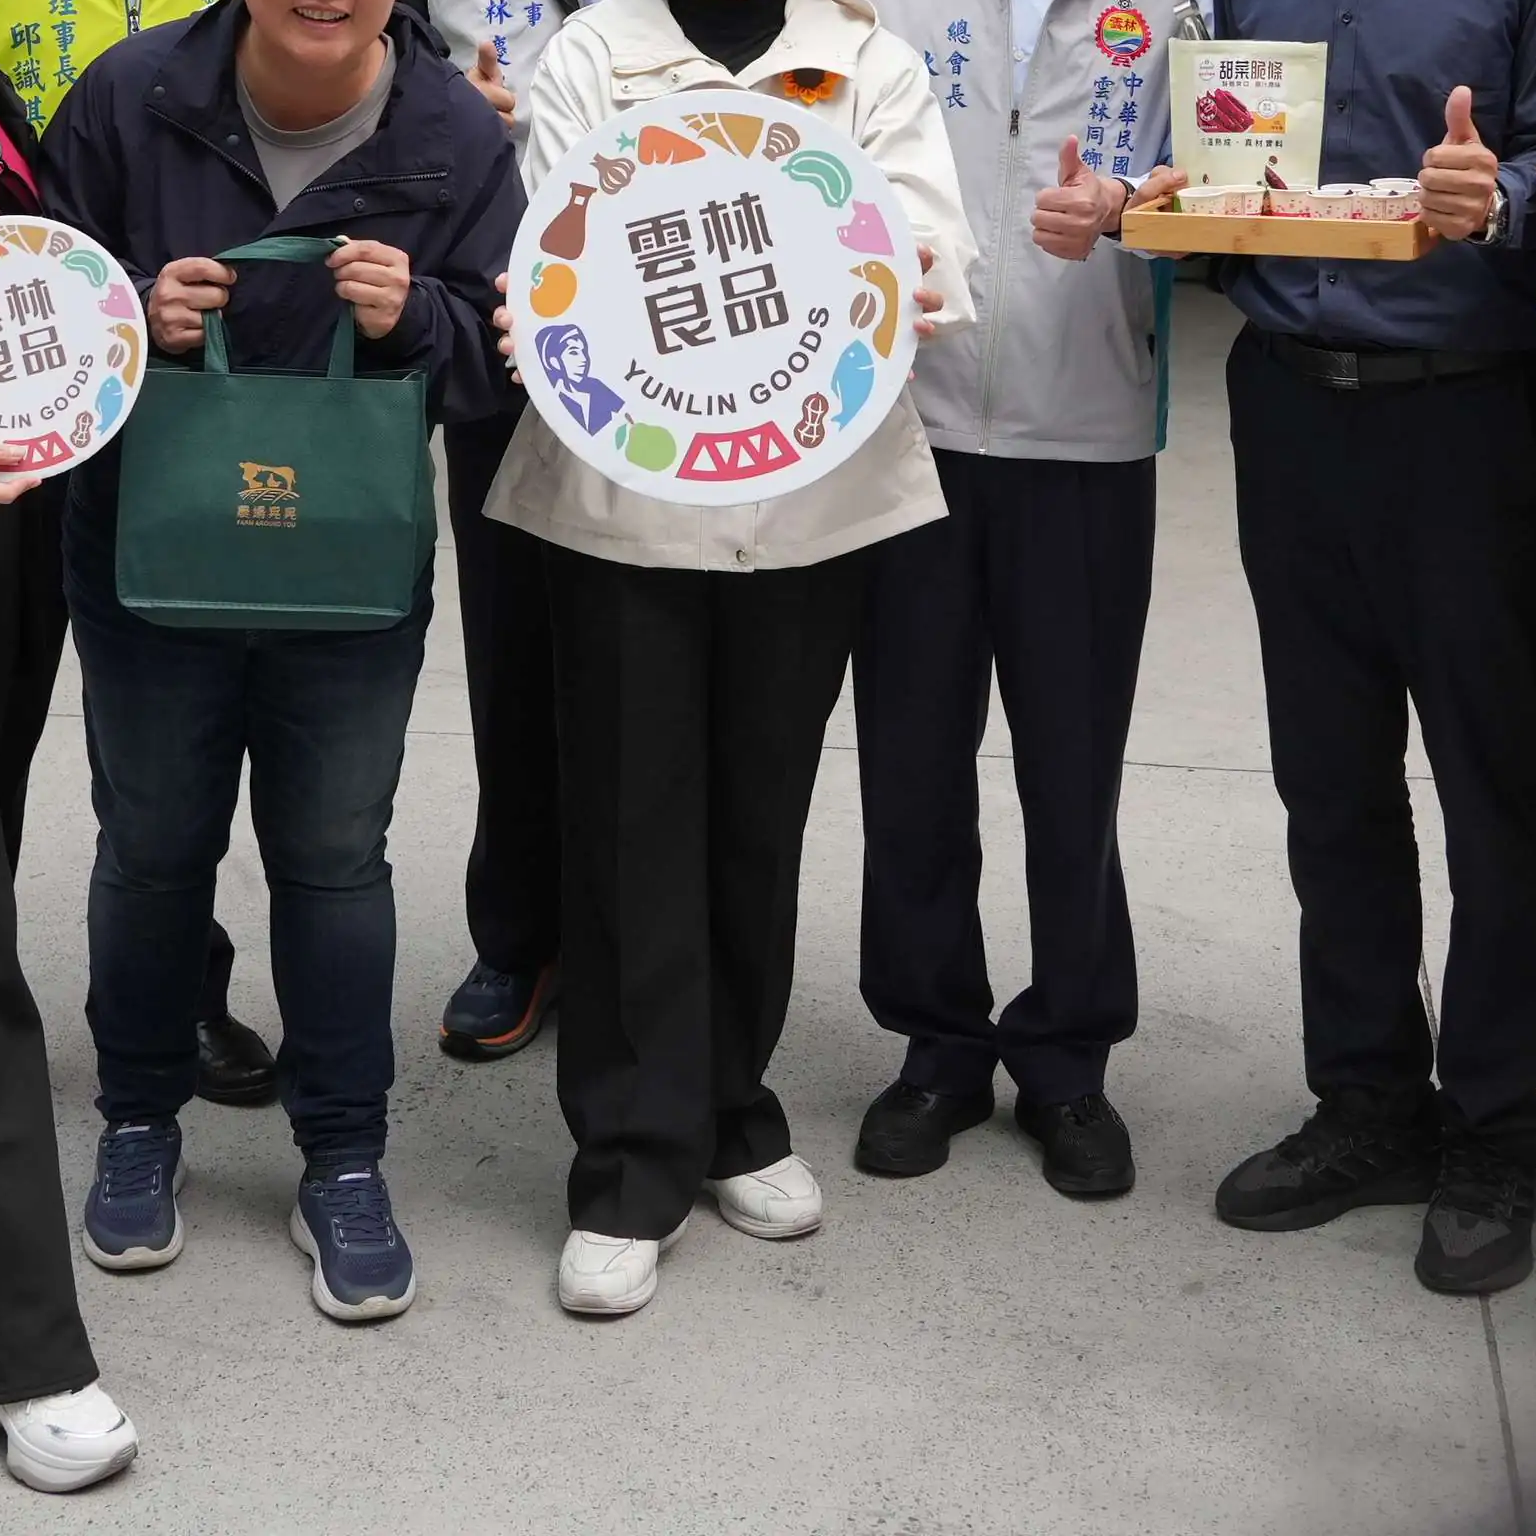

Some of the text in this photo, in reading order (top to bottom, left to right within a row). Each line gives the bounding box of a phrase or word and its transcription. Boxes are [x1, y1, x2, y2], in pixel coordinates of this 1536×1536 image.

[945, 19, 971, 109] 總會長
[1110, 16, 1138, 33] 雲林
[1219, 60, 1283, 80] 甜菜脆條
[1081, 75, 1116, 173] 雲林同鄉
[1112, 72, 1144, 177] 中華民國
[625, 191, 774, 283] 雲林
[644, 262, 790, 356] 良品
[40, 353, 95, 421] GOODS
[625, 306, 830, 416] YUNLIN GOODS
